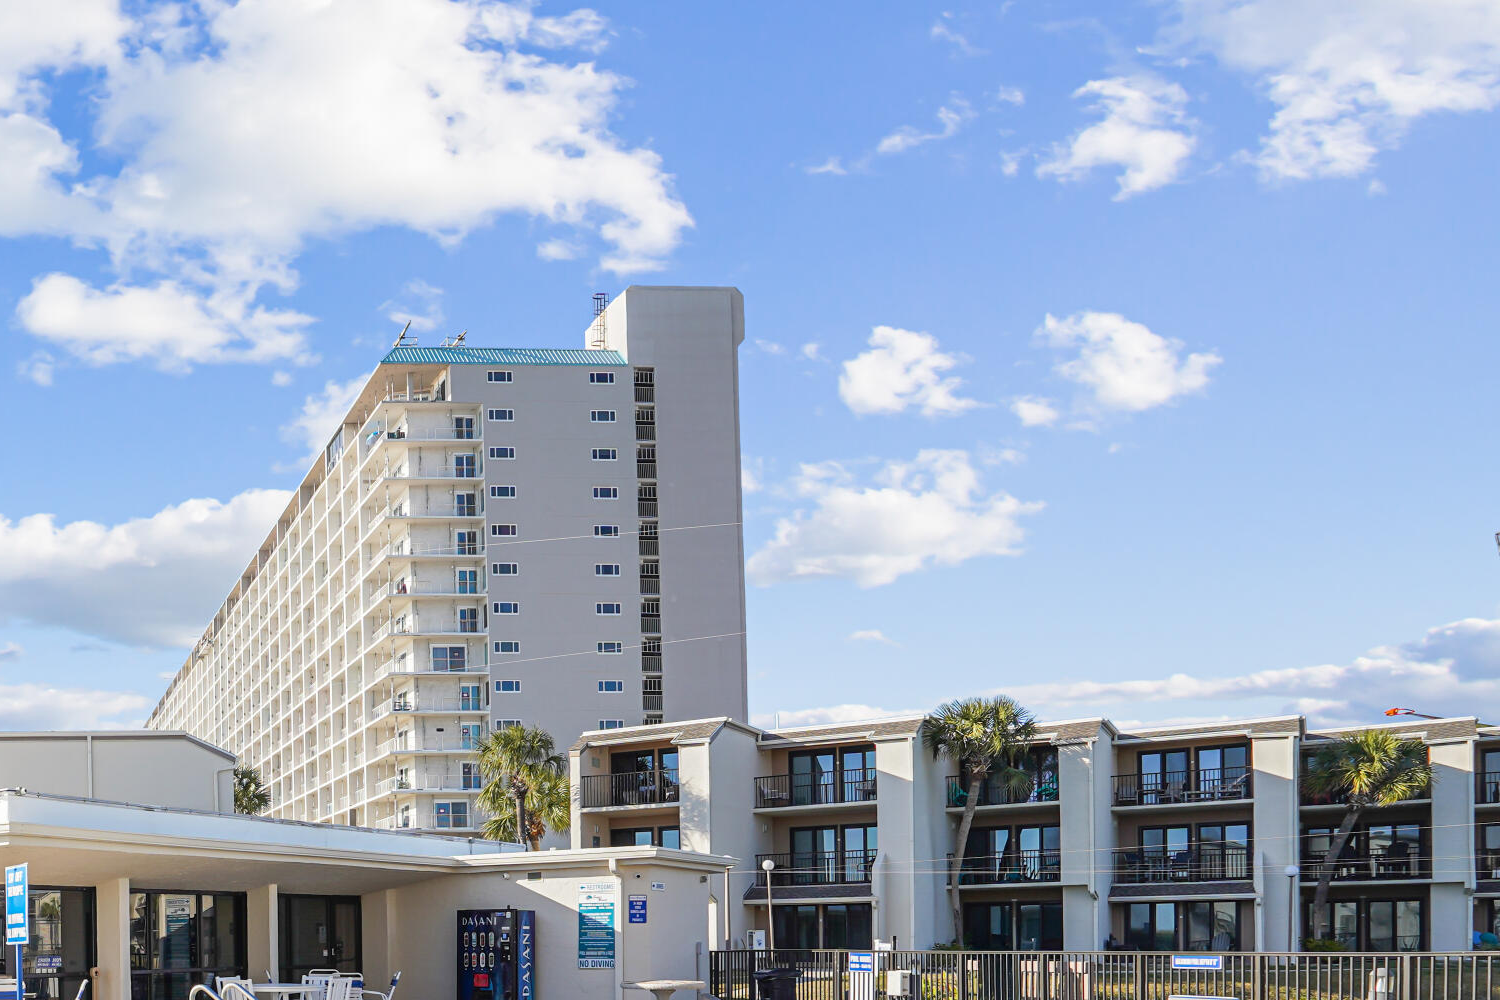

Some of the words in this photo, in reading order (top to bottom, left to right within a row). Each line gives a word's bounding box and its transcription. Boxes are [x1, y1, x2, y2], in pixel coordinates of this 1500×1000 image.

[462, 914, 497, 927] DASANI
[521, 925, 531, 997] DASANI
[580, 960, 589, 968] NO
[591, 960, 615, 968] DIVING
